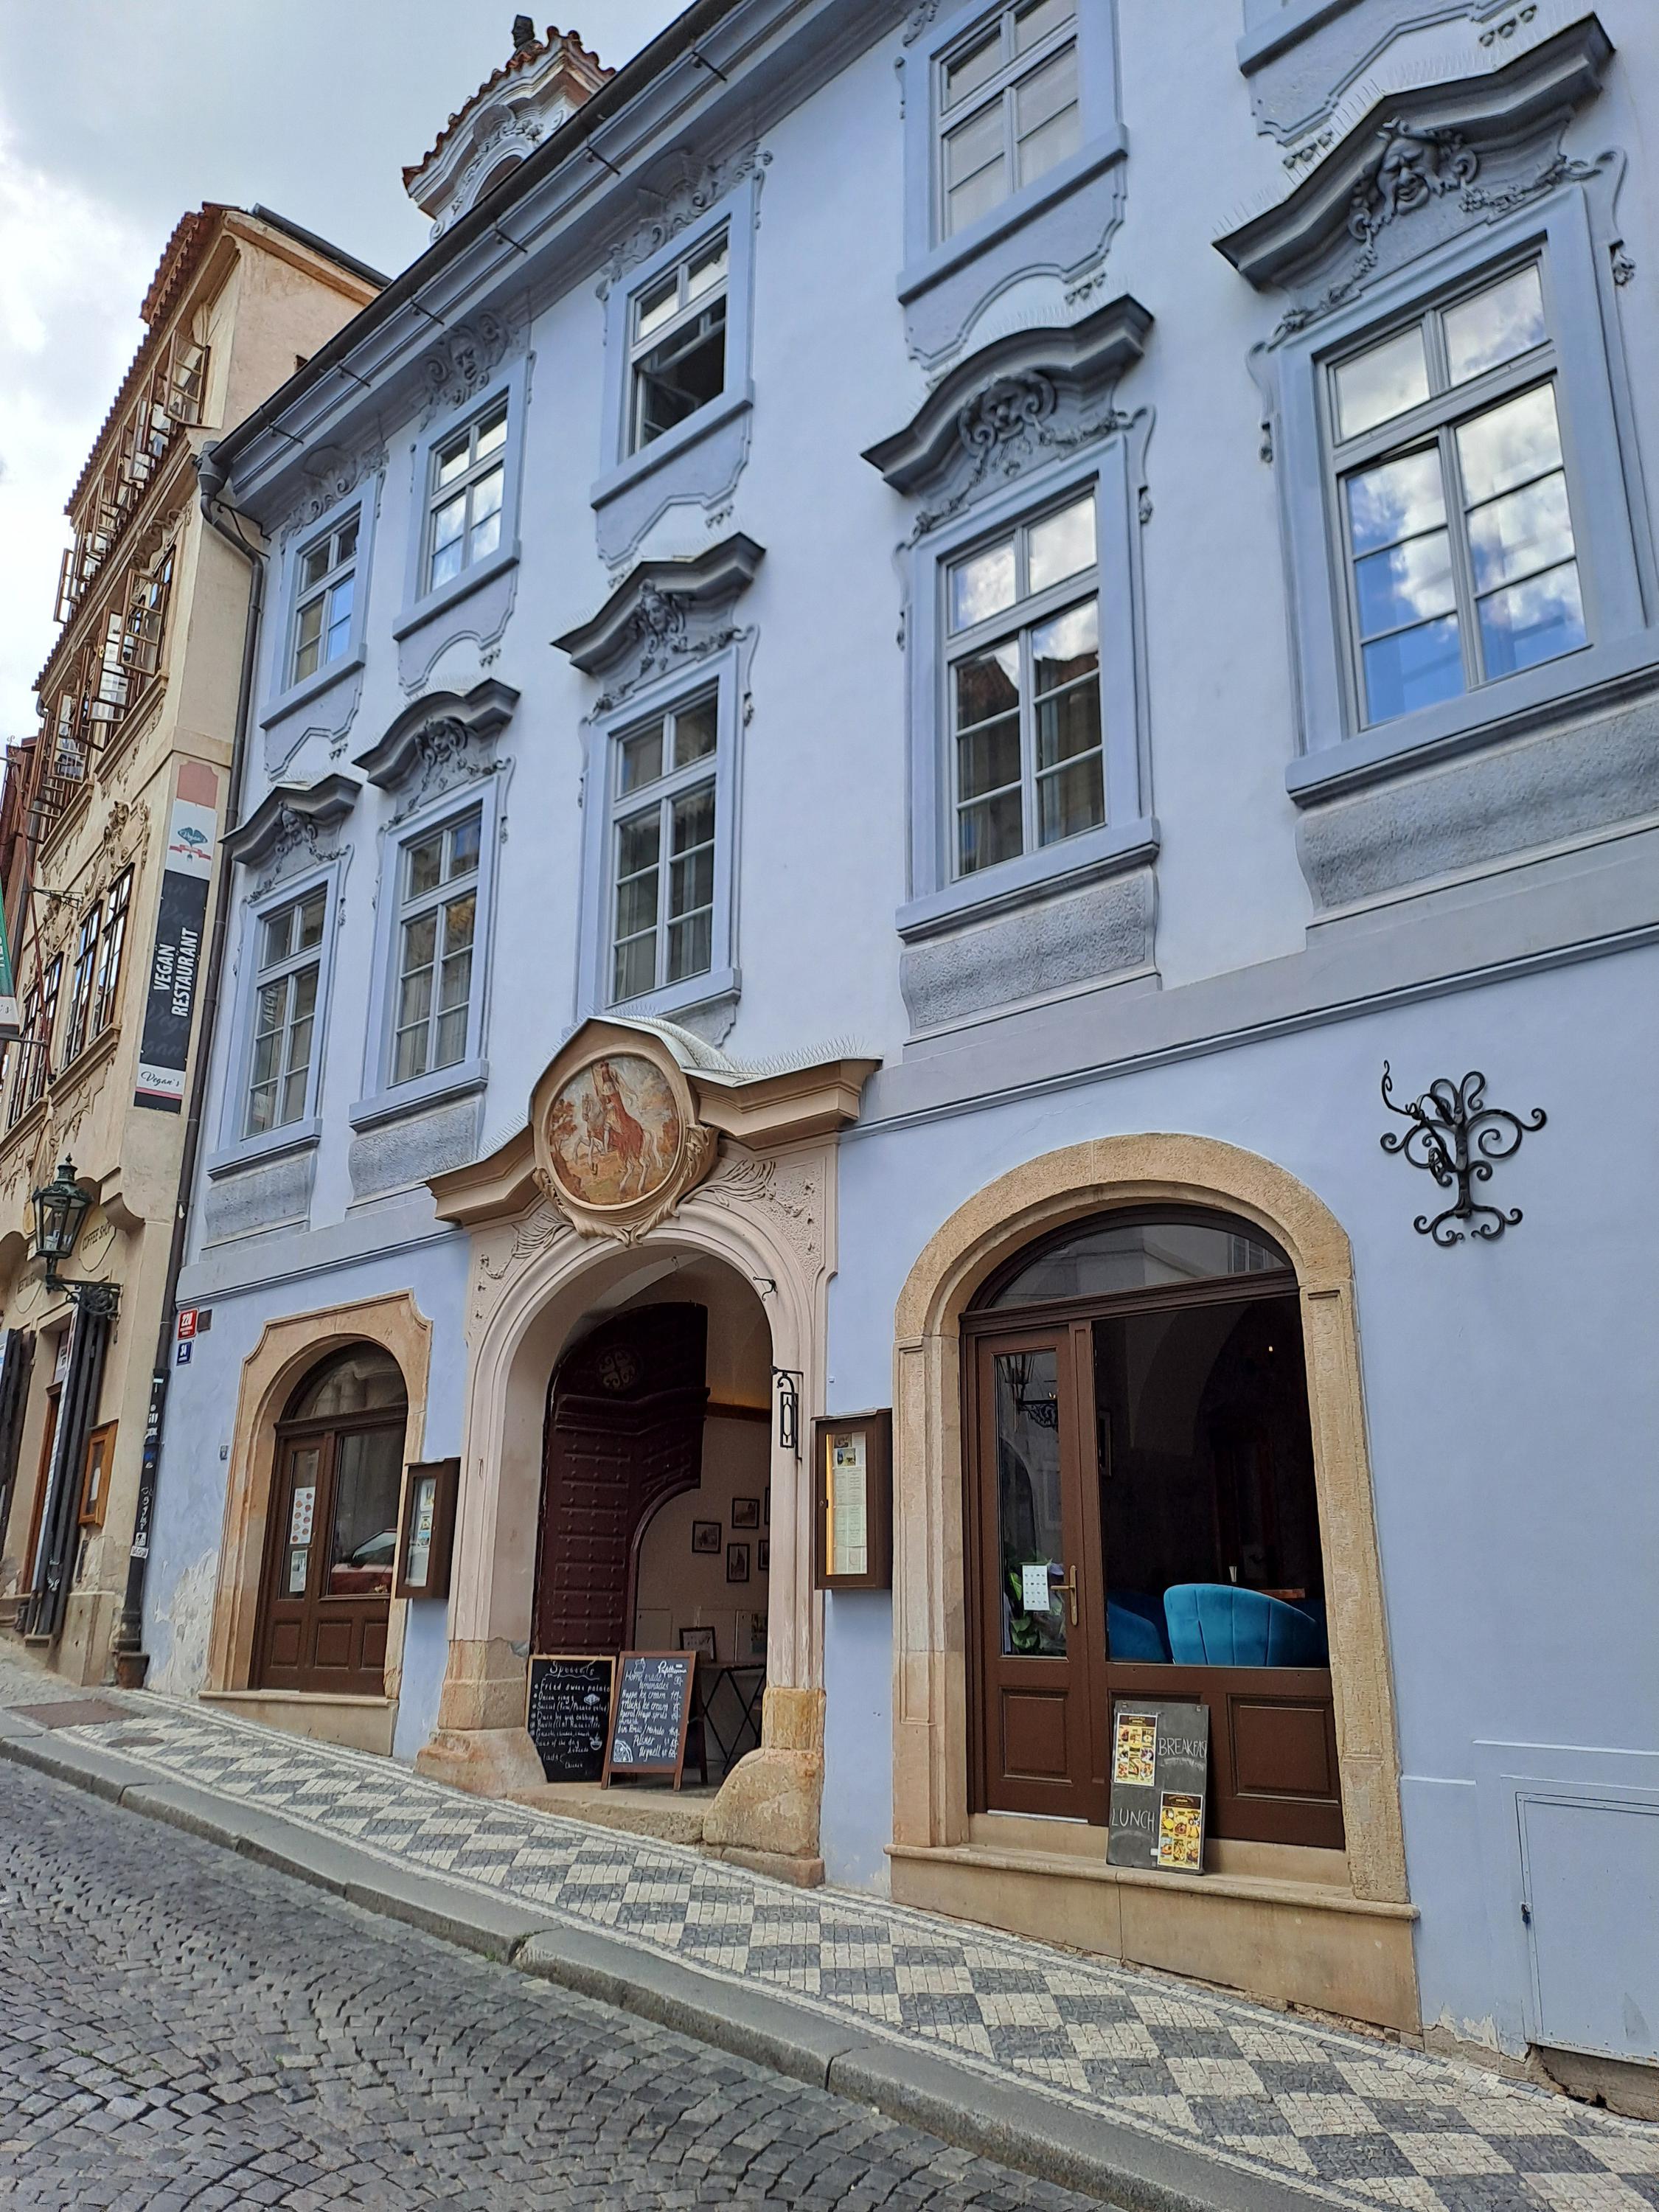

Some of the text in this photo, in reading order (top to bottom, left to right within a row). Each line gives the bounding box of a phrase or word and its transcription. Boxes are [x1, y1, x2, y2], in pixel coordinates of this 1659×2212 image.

[153, 943, 175, 990] VEGAN
[171, 927, 198, 1017] RESTAURANT
[141, 1071, 180, 1087] Vegan's
[625, 1671, 643, 1682] Home
[644, 1672, 662, 1682] made
[1112, 1808, 1155, 1833] LUNCH
